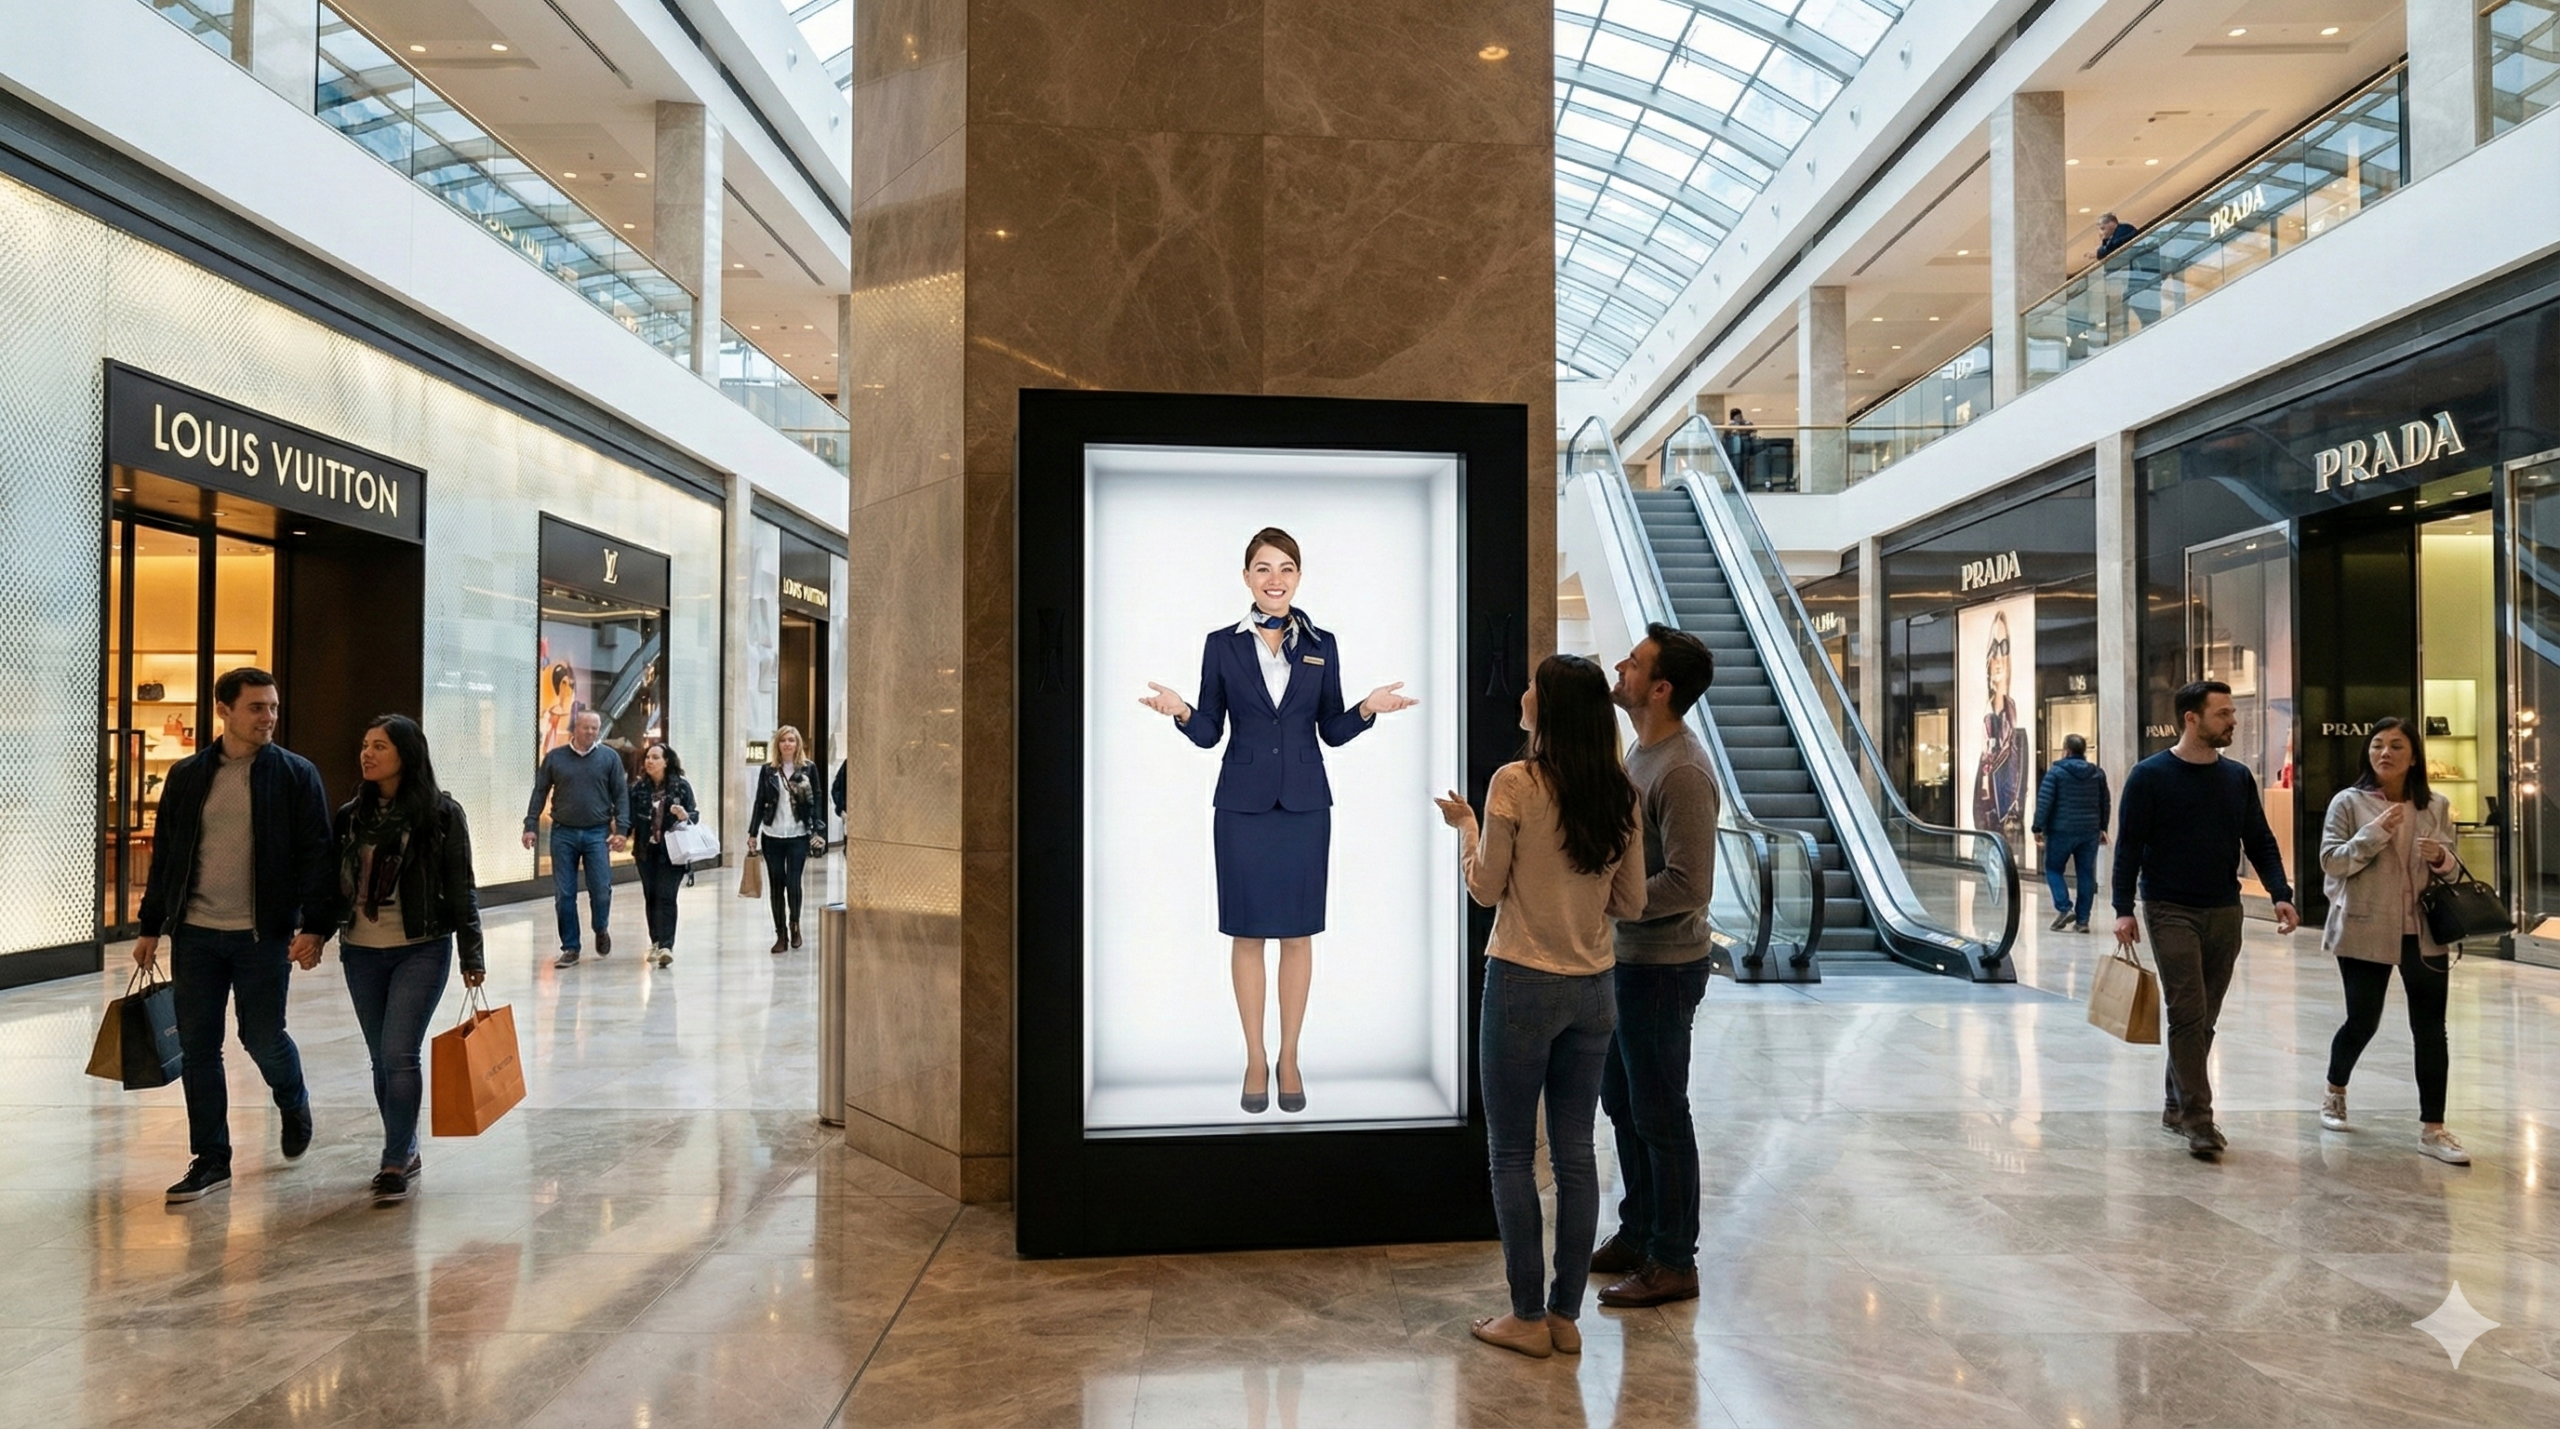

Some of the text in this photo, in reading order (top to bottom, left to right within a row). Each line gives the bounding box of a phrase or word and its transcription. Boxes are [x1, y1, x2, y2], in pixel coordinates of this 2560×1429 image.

[2210, 184, 2266, 238] PRADA
[155, 403, 398, 518] LOUIS VUITTON
[2314, 410, 2466, 493] PRADA
[1961, 550, 2021, 592] PRADA
[2322, 722, 2374, 736] PRAD
